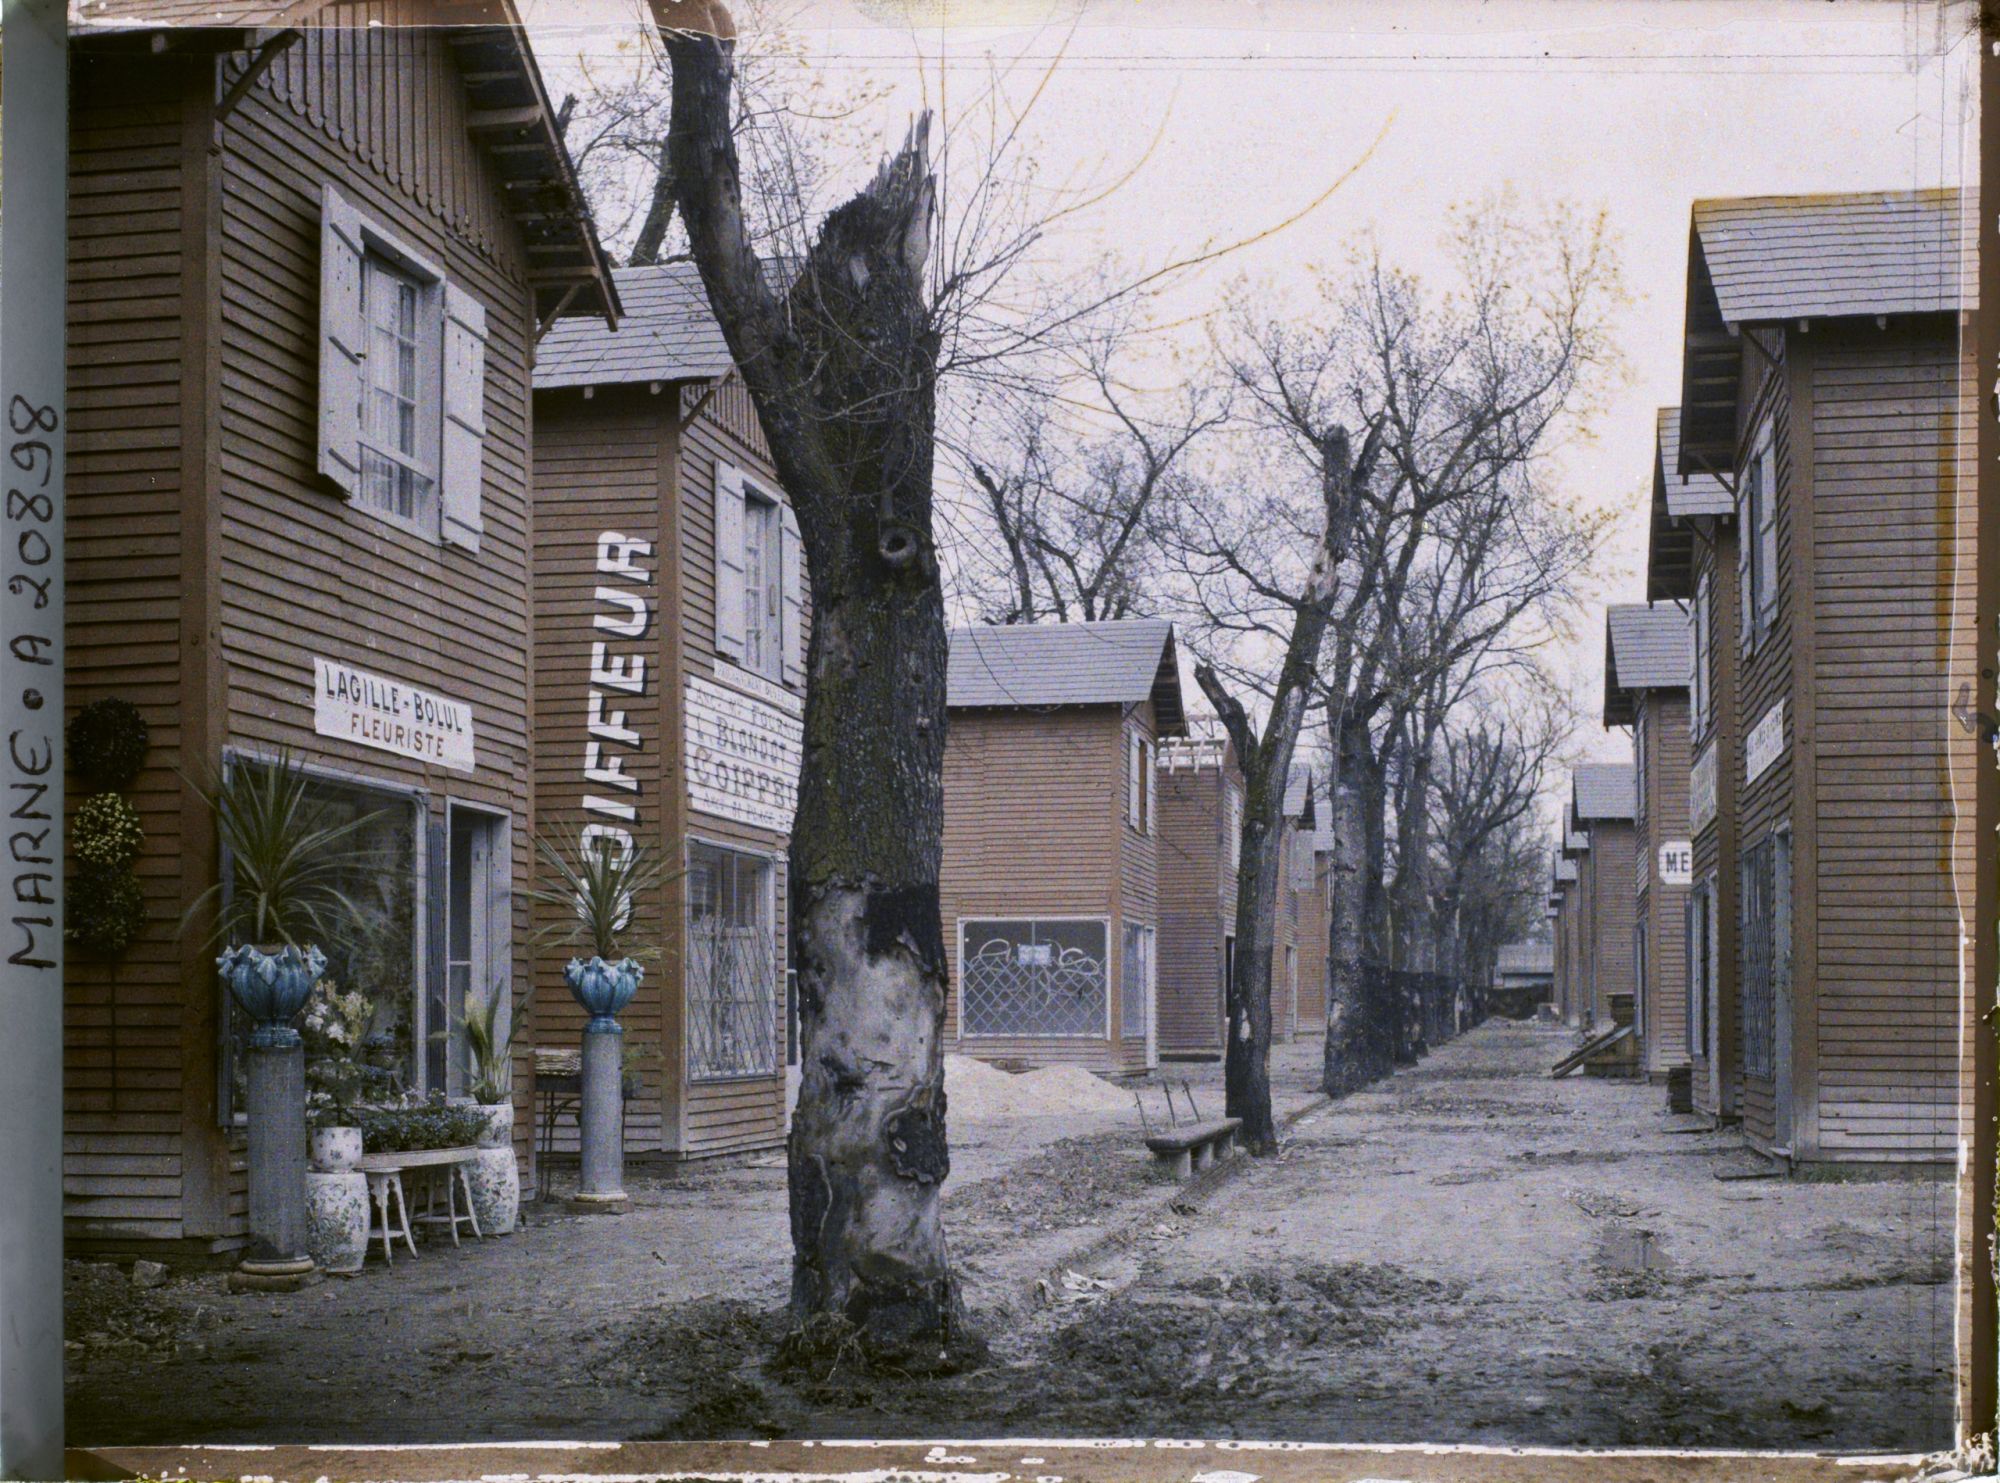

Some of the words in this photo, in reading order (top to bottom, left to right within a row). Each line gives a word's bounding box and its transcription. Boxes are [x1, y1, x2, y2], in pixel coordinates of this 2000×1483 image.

[7, 394, 58, 610] 20898
[10, 633, 53, 666] A
[351, 713, 444, 757] FLEURISTE
[8, 730, 57, 969] MARNE
[1666, 852, 1689, 873] ME
